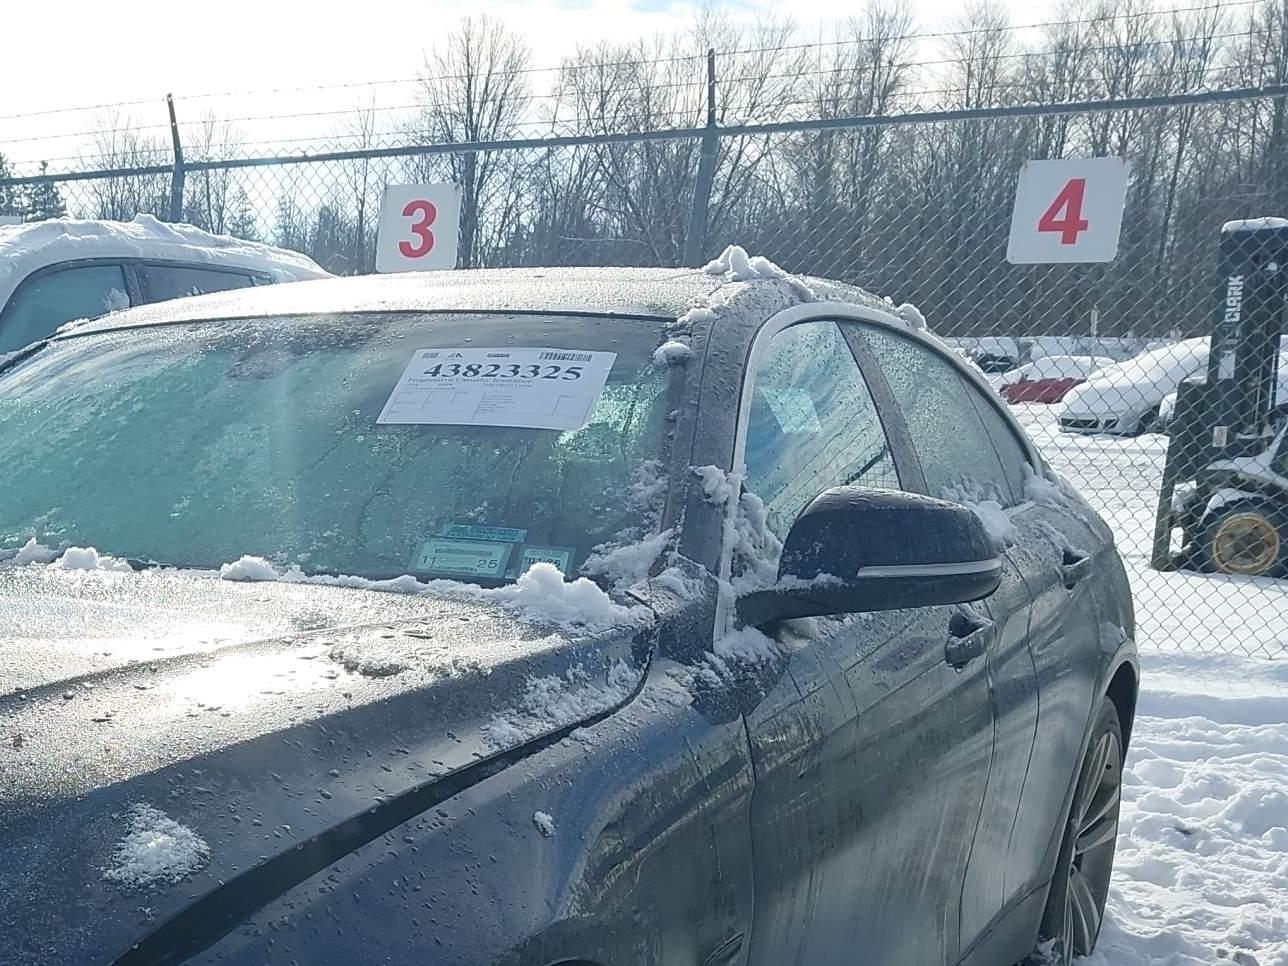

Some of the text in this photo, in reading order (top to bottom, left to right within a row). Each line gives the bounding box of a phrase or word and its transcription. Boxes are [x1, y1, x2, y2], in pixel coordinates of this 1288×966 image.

[401, 202, 435, 258] 3
[1039, 180, 1086, 244] 4
[1224, 275, 1244, 322] CLARK
[423, 363, 584, 381] 43823325
[477, 559, 499, 569] 25
